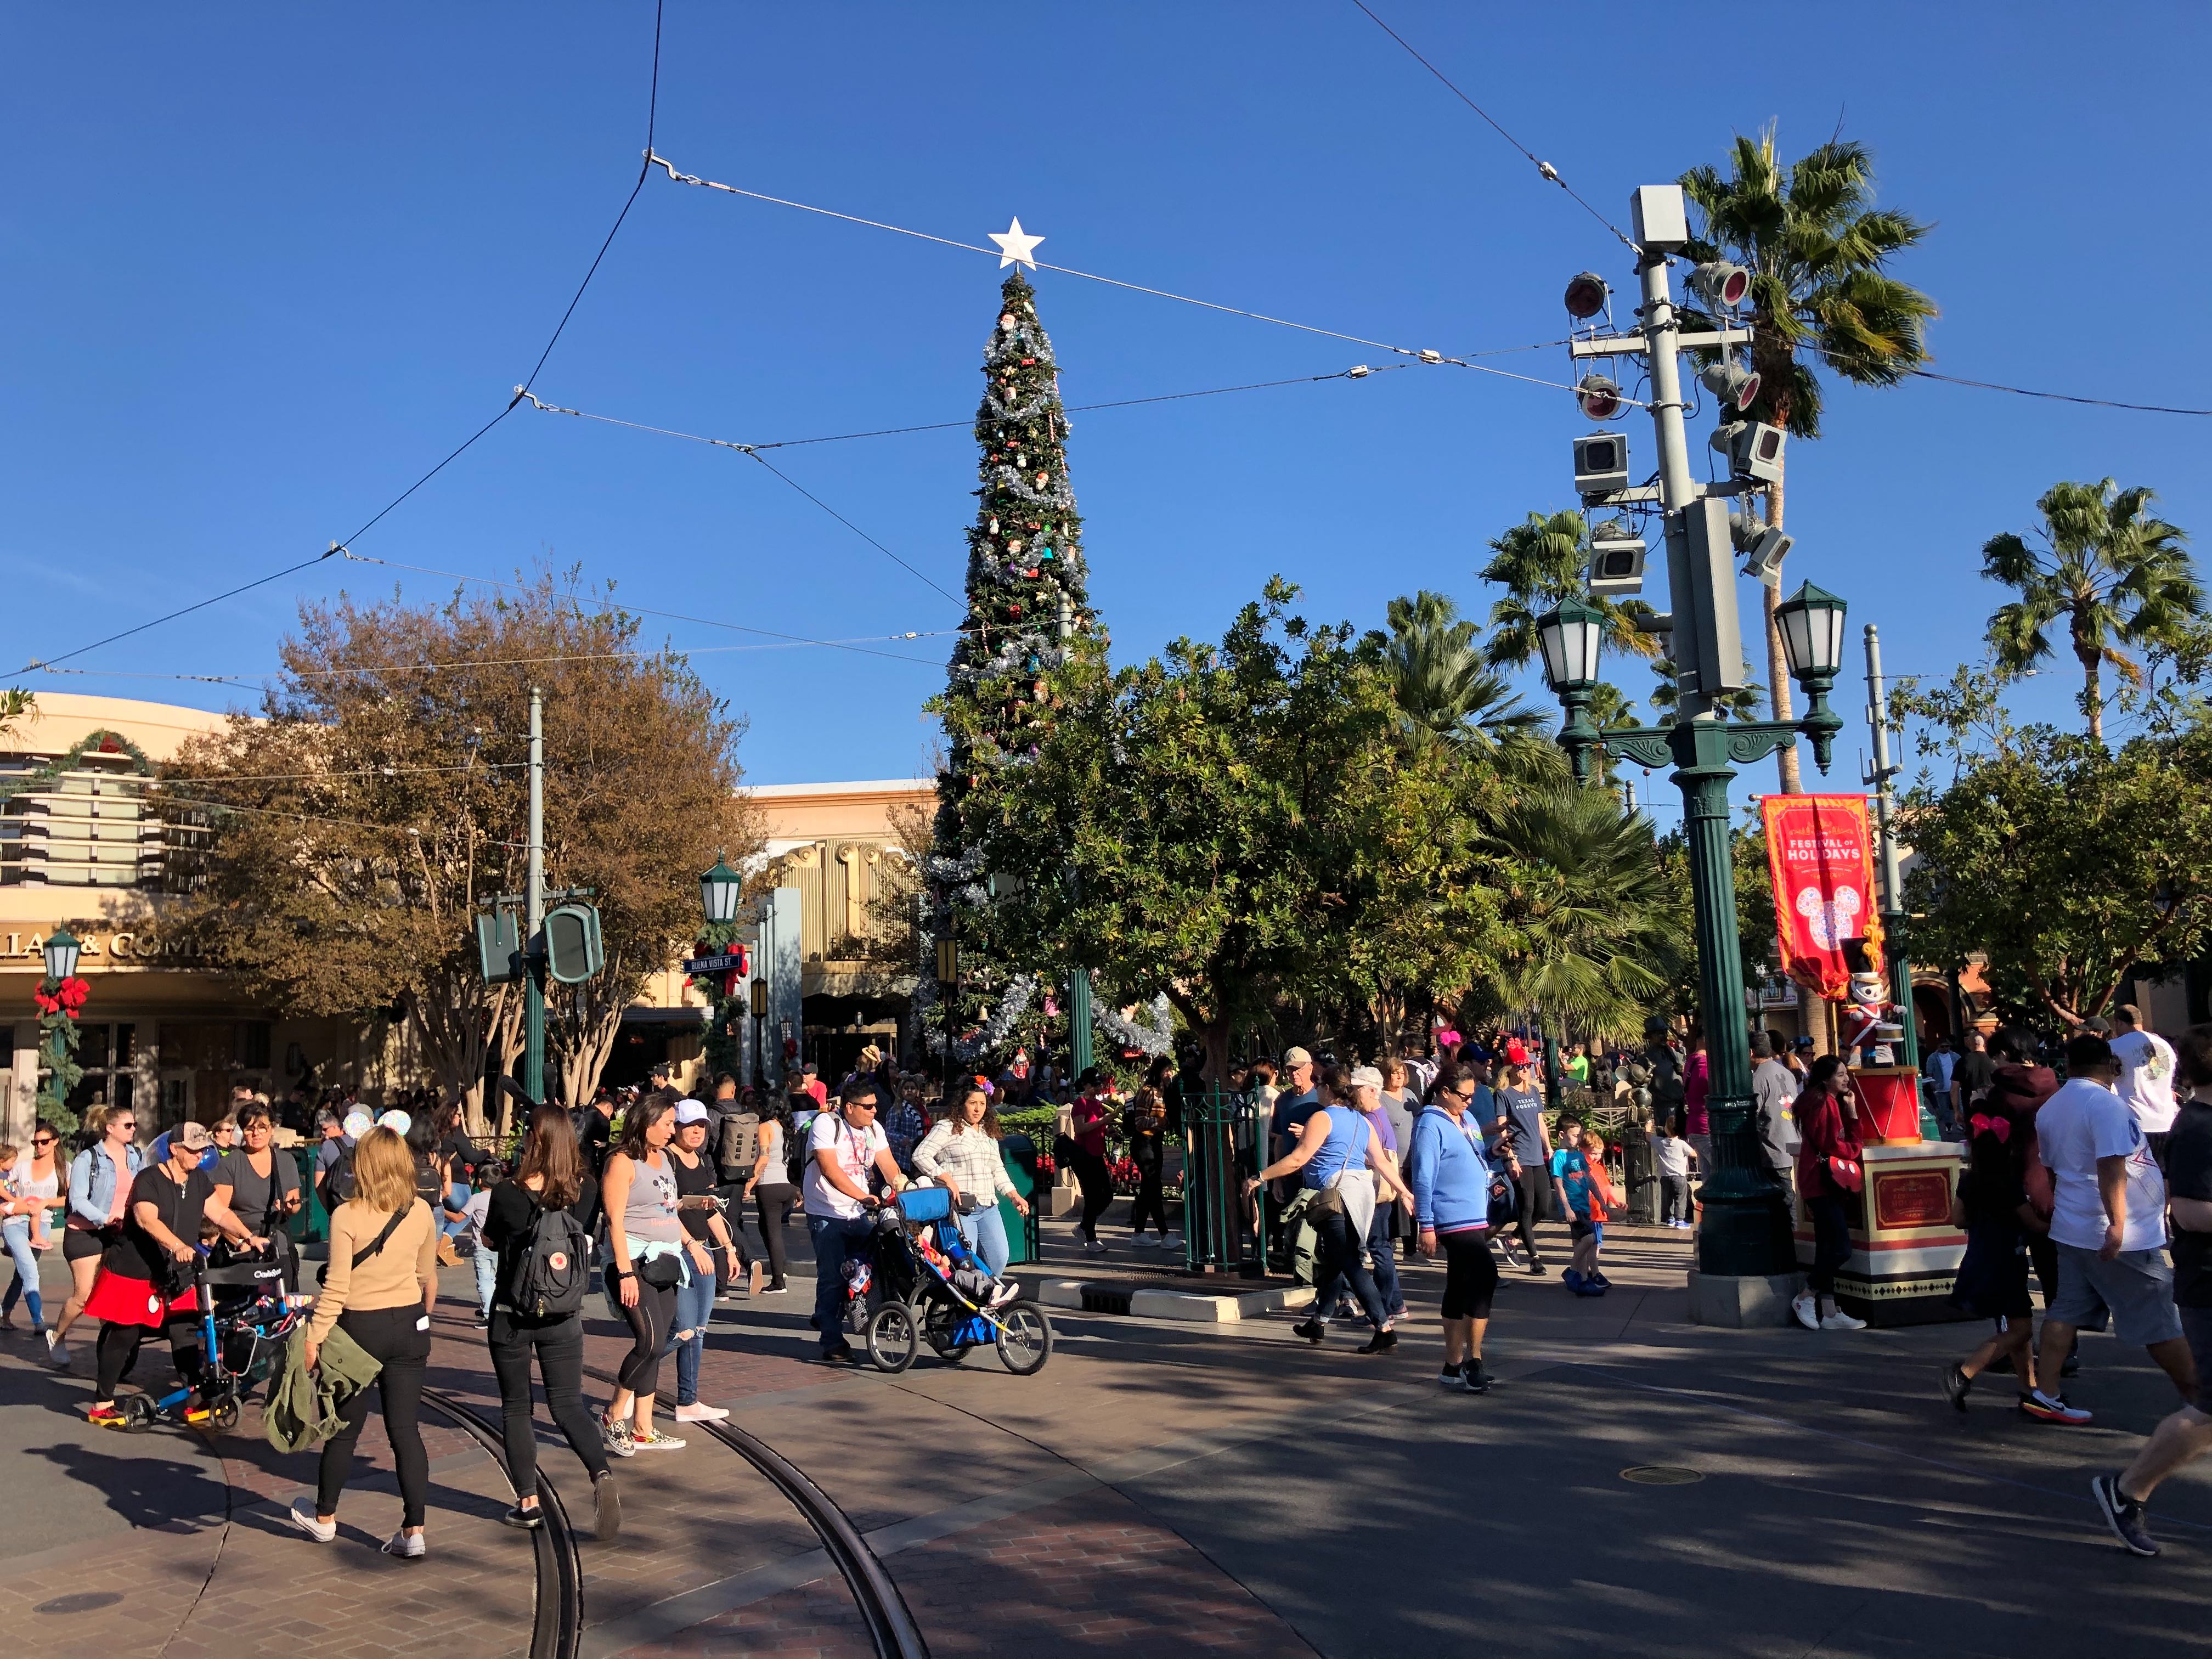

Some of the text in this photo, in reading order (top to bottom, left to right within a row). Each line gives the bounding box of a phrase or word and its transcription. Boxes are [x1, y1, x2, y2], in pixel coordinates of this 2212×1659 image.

[1790, 839, 1843, 848] FESTIVAL
[1787, 848, 1860, 860] HOLIDAYS
[81, 934, 103, 954] &
[691, 960, 708, 970] BUENA
[709, 958, 723, 968] VISTA
